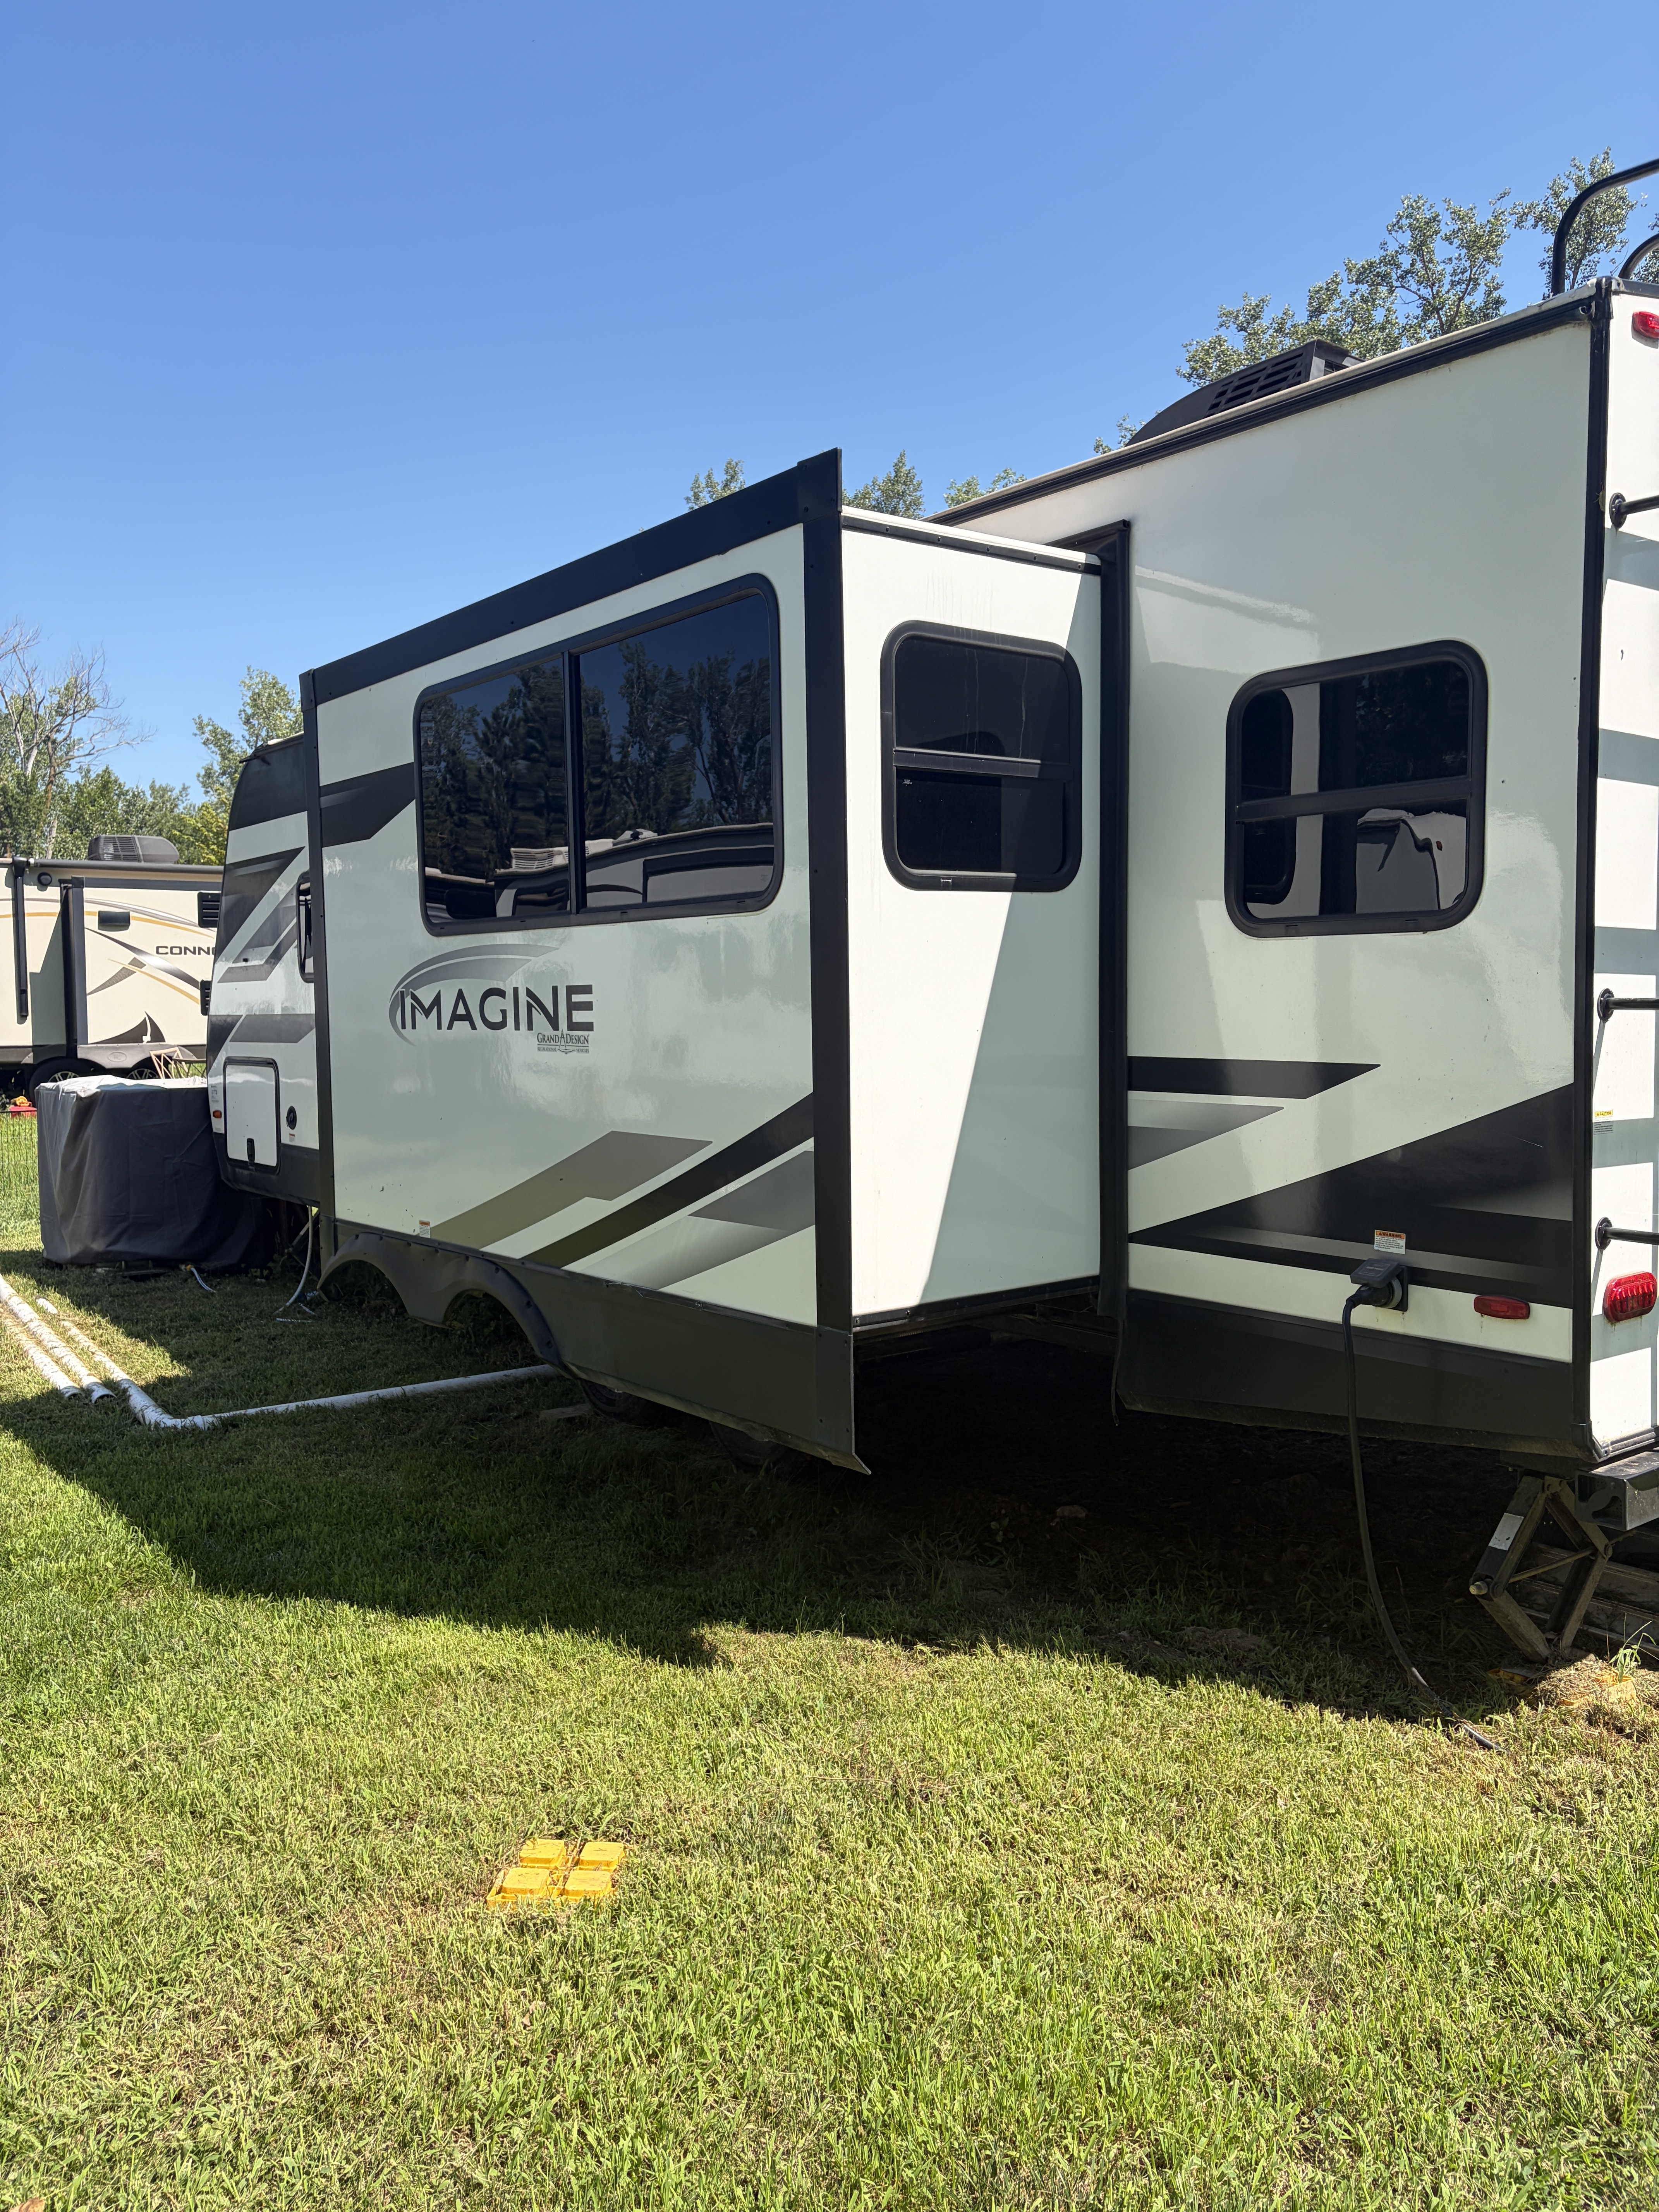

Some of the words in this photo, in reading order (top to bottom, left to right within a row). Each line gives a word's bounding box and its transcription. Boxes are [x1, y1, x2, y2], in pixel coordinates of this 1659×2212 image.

[156, 946, 215, 955] CONN
[400, 984, 594, 1031] IMAGINE
[537, 1032, 559, 1043] GRAND
[566, 1033, 589, 1044] DESIGN
